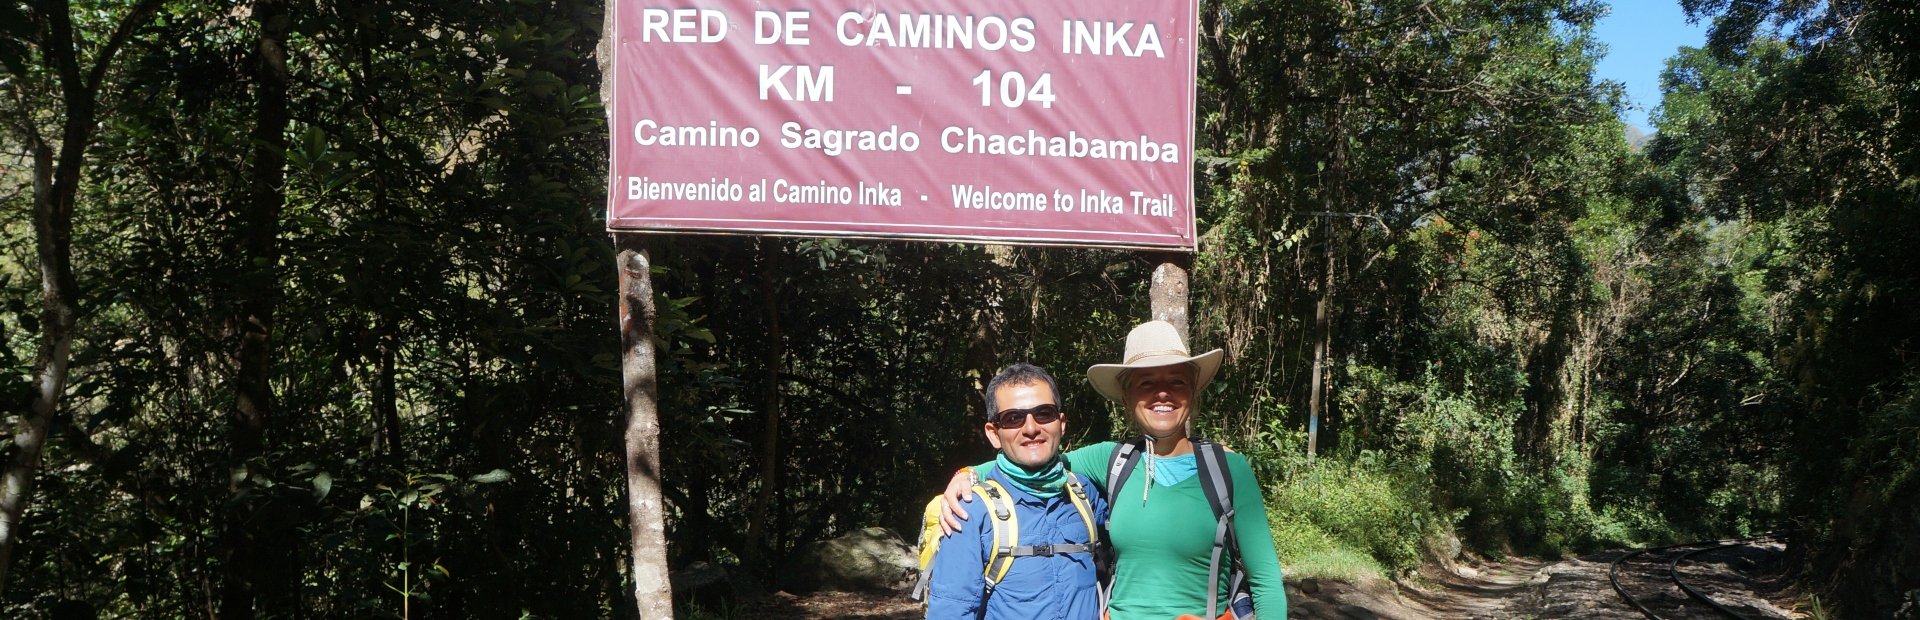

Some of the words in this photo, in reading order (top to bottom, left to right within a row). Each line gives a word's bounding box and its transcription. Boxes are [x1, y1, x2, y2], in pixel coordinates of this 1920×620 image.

[642, 8, 728, 43] RED
[754, 10, 810, 46] DE
[836, 11, 1036, 53] CAMINOS
[1062, 20, 1165, 58] INKA
[759, 63, 834, 102] KM
[972, 70, 1056, 109] 104
[634, 119, 760, 148] Camino
[780, 121, 920, 156] Sagrado
[941, 126, 1179, 164] Chachabamba
[628, 176, 743, 202] Bienvenido
[748, 178, 767, 203] al
[773, 178, 853, 205] Camino
[859, 181, 902, 207] Inka
[951, 184, 1047, 212] Welcome
[1053, 188, 1074, 213] to
[1080, 188, 1124, 215] Inka
[1129, 191, 1173, 218] Trail
